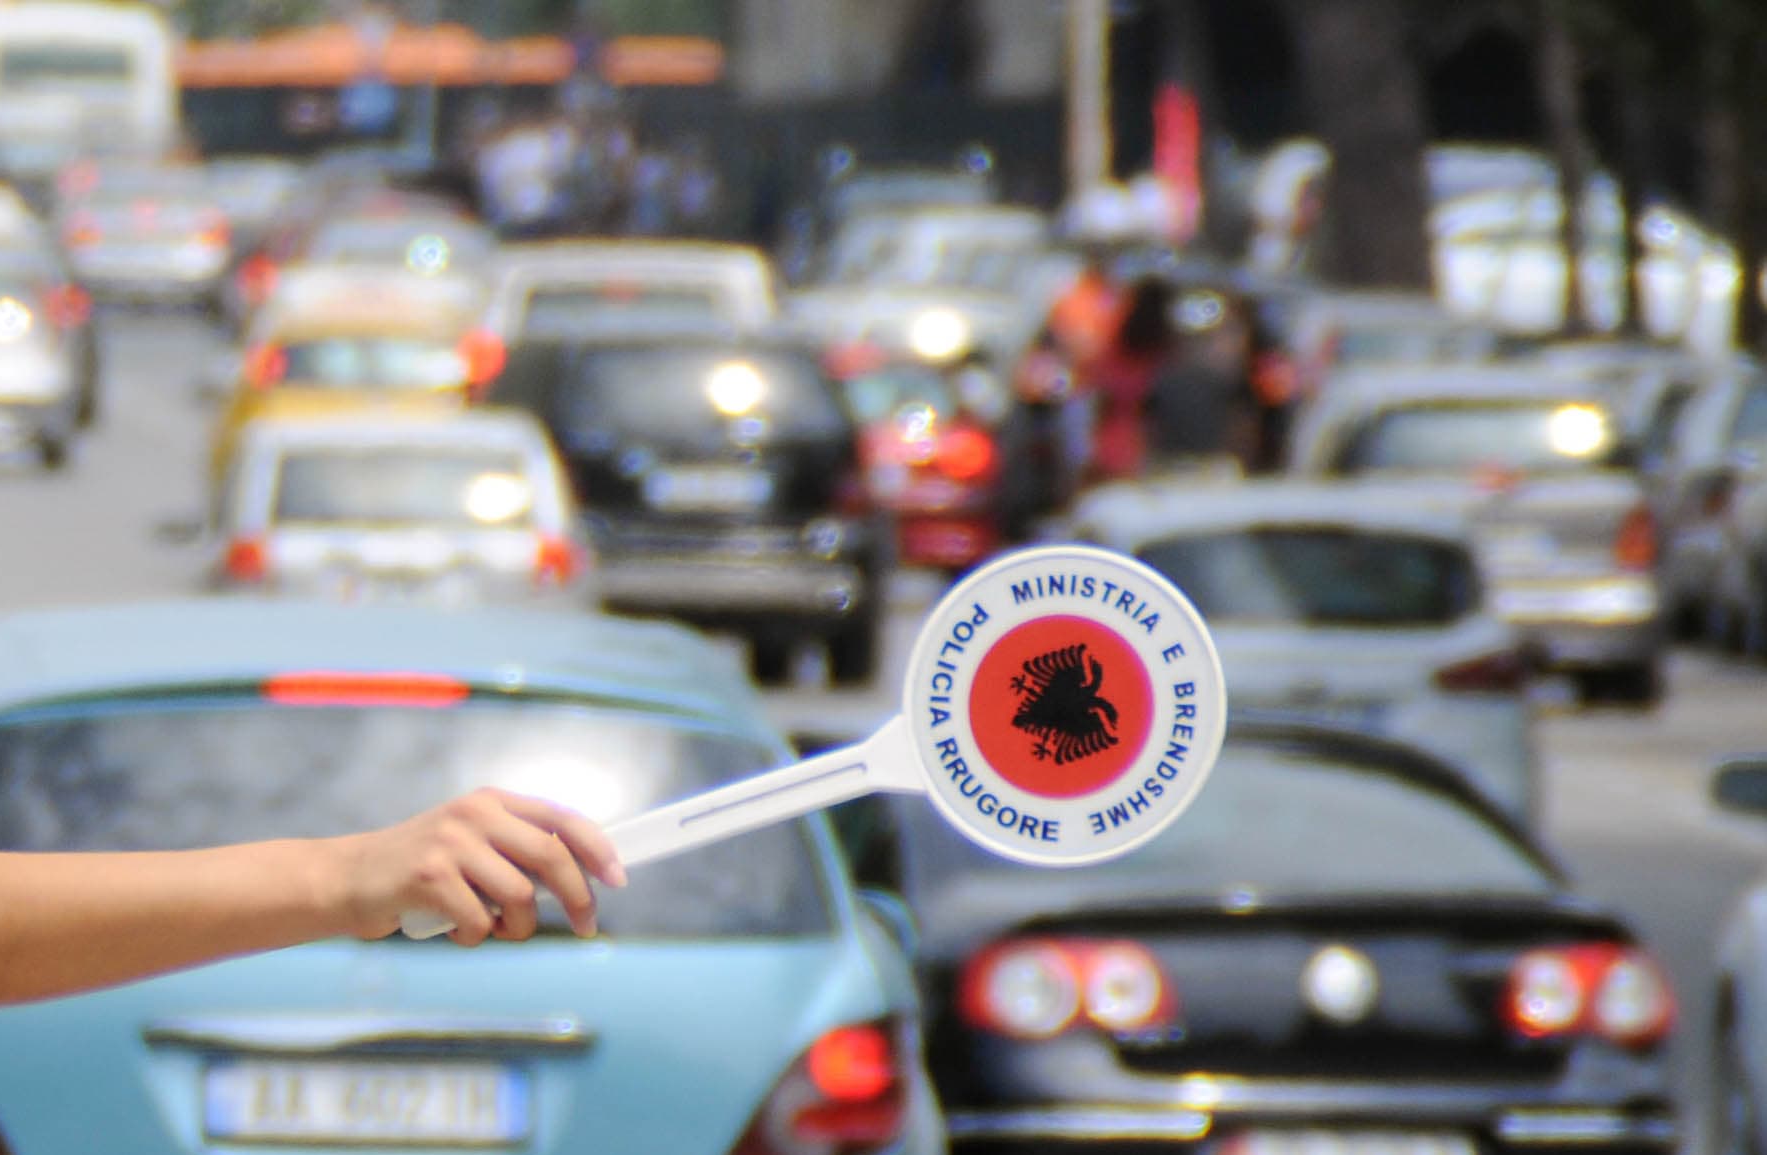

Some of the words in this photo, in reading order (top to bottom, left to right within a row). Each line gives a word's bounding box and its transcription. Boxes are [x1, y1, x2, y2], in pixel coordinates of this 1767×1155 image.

[1010, 575, 1160, 633] MINISTRIA
[1161, 643, 1185, 663] E
[929, 603, 990, 727] POLICIA
[935, 737, 1059, 842] RRUGORE
[1088, 681, 1196, 834] BRENDSHME
